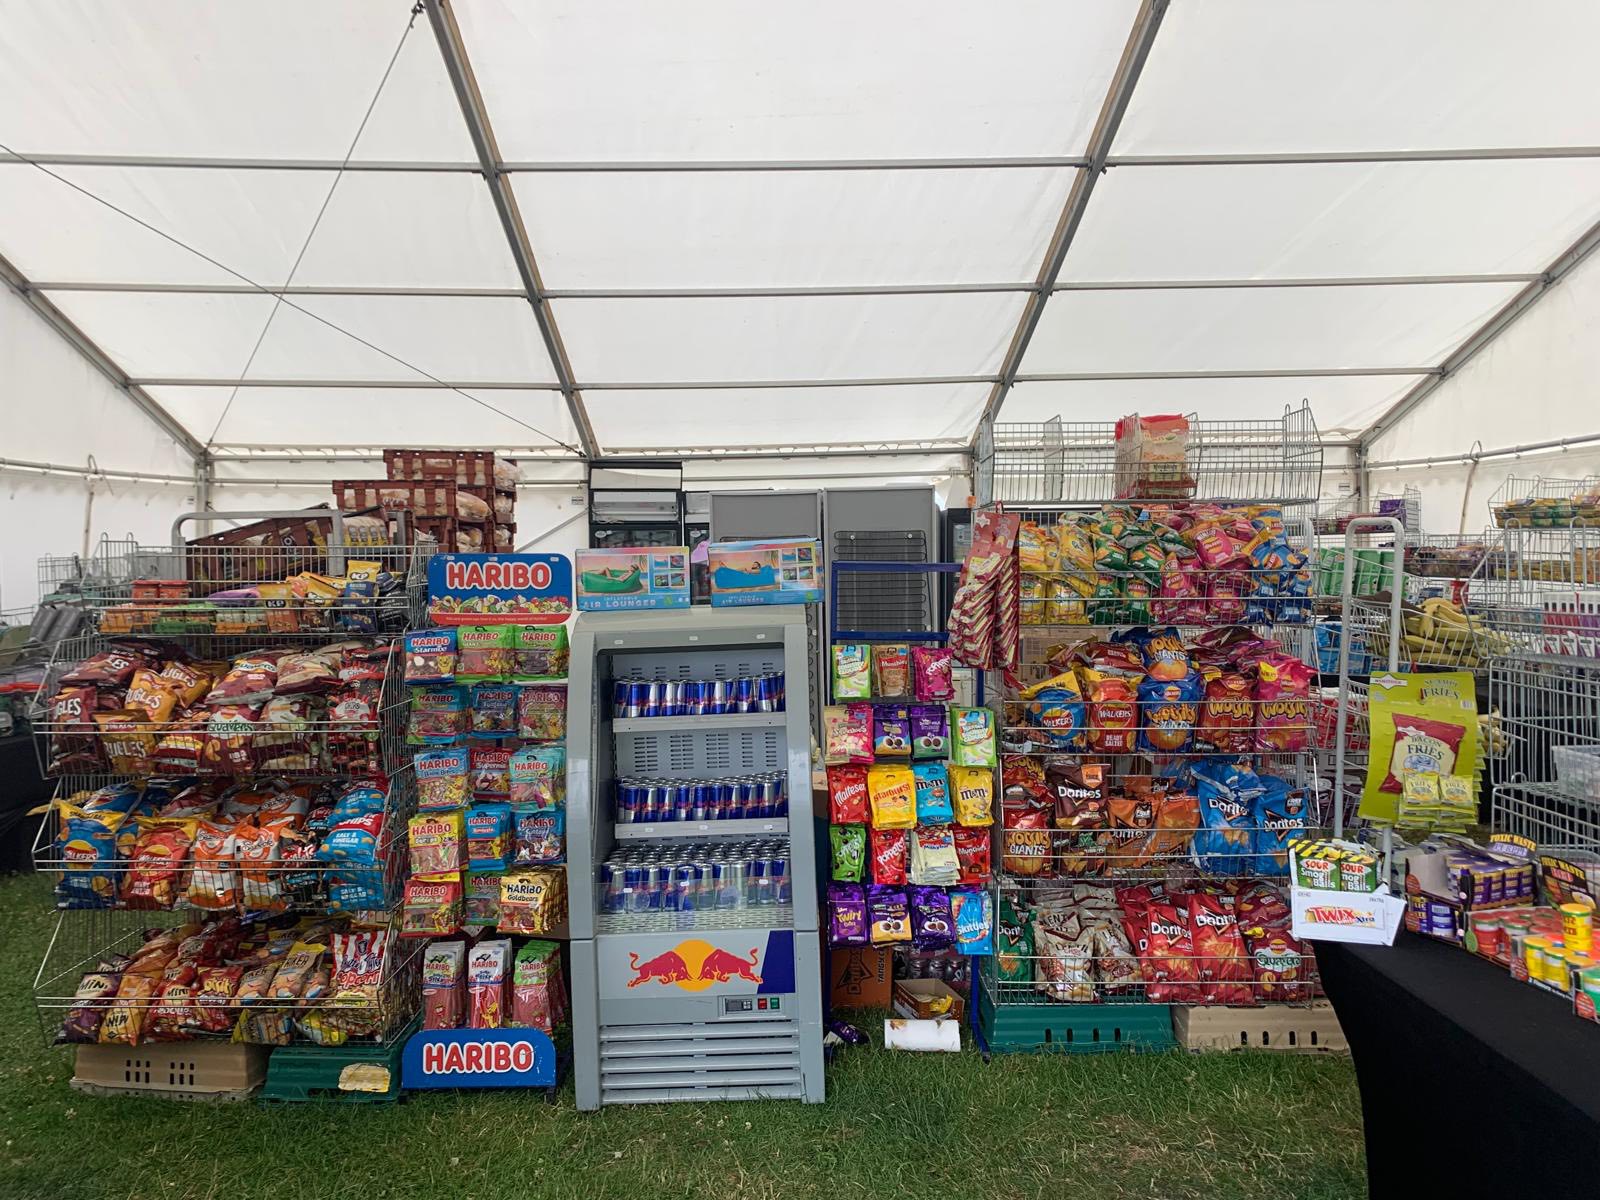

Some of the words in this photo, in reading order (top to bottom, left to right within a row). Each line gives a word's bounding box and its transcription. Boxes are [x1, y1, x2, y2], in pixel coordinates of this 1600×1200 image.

[349, 571, 369, 580] KP
[448, 562, 551, 589] HARIBO
[266, 600, 286, 608] KP
[606, 600, 656, 608] LOUNGER
[463, 632, 498, 640] HARIBO
[522, 632, 556, 641] HARIBO
[412, 637, 450, 646] HARIBO
[415, 646, 448, 654] Starmix
[478, 692, 513, 701] HARIBO
[522, 692, 560, 702] HARIBO
[1424, 688, 1459, 700] FRIES
[1098, 710, 1132, 718] WALKERS
[1043, 716, 1072, 727] WALKERS
[1411, 736, 1442, 748] BACON
[474, 752, 510, 762] HARIBO
[1408, 744, 1444, 761] FRIES
[419, 759, 458, 769] HARIBO
[1058, 786, 1102, 800] Doritos
[1209, 798, 1248, 816] Doritos
[520, 818, 555, 828] HARIBO
[413, 824, 451, 836] HARIBO
[1490, 833, 1513, 843] TOXIC
[1514, 836, 1536, 851] WASTE
[1010, 844, 1046, 856] GIANTS
[1305, 861, 1328, 870] SOUR
[1340, 863, 1363, 873] SOUR
[1558, 860, 1585, 880] WASTE
[410, 887, 446, 897] HARIBO
[507, 885, 542, 894] HARIBO
[508, 894, 538, 902] Goldbears
[1310, 906, 1356, 924] TWIX
[1196, 914, 1237, 927] Doritos
[957, 922, 990, 934] Skittles
[1151, 922, 1192, 938] Doritos
[423, 1041, 533, 1074] HARIBO
